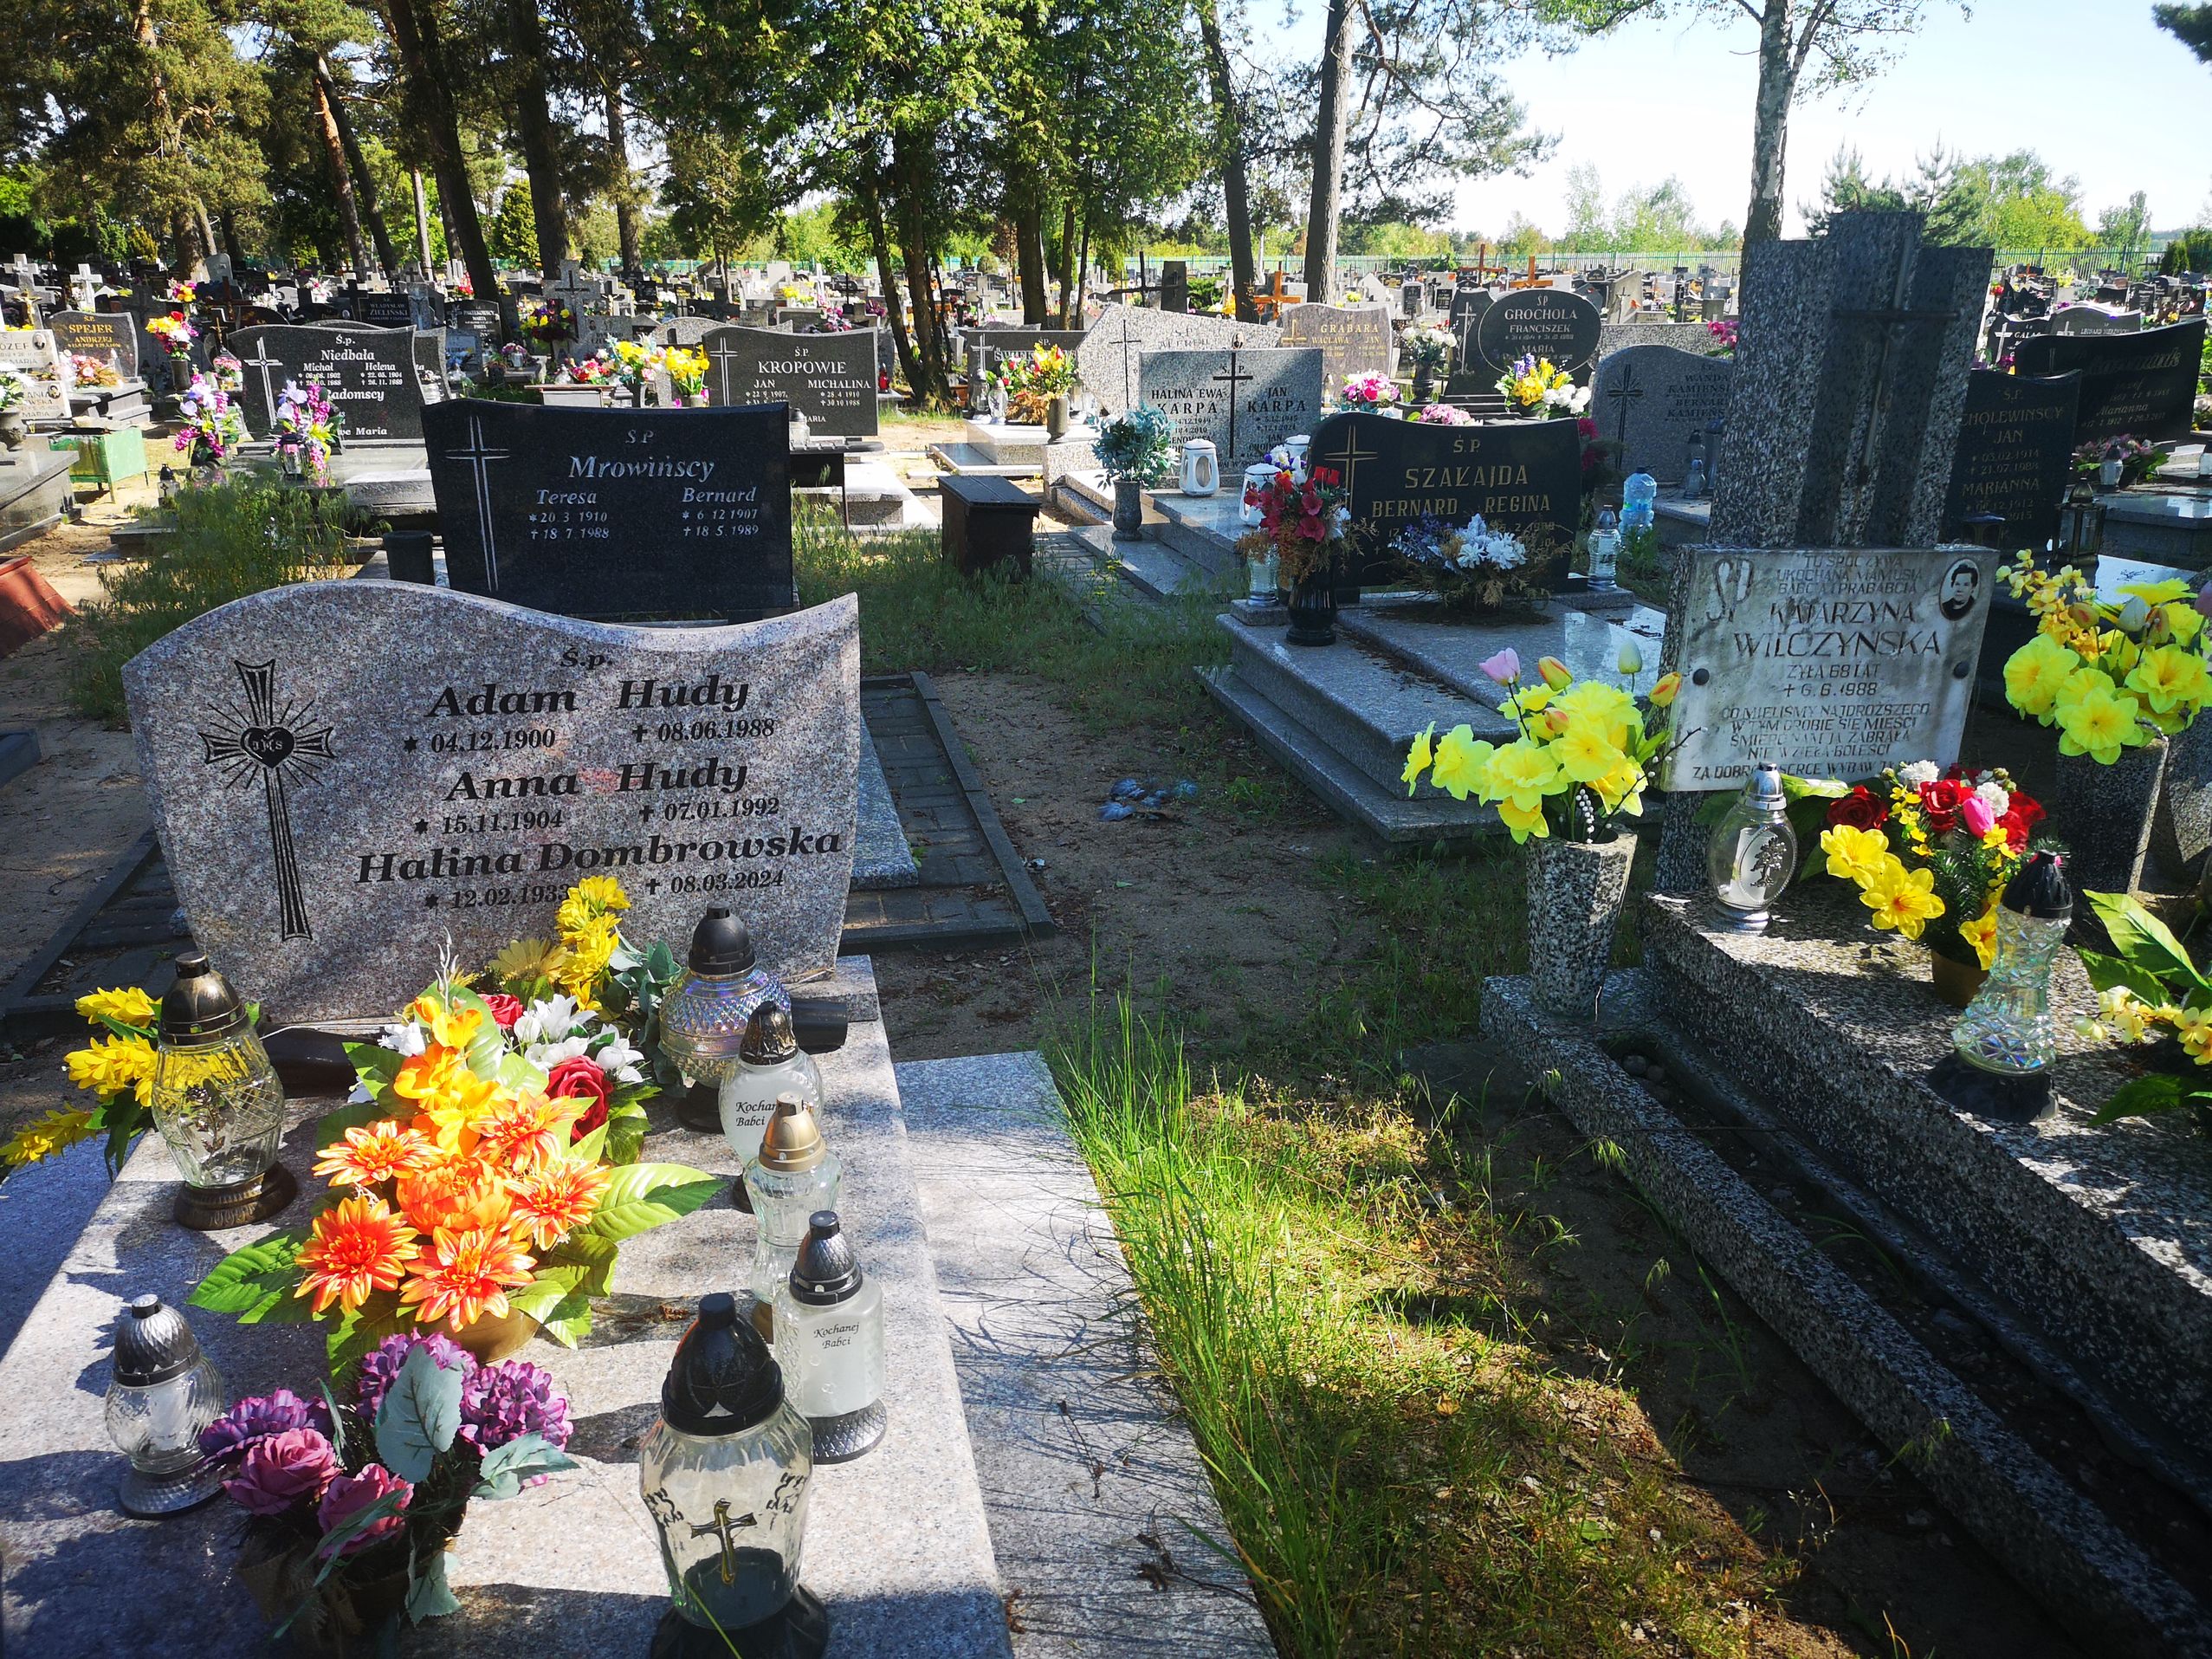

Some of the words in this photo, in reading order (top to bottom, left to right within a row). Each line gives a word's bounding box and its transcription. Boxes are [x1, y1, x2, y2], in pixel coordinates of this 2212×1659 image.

[1504, 308, 1578, 321] GROCHOLA
[69, 324, 114, 334] SPEJER
[1321, 324, 1379, 333] GRABARA
[1510, 324, 1571, 334] FRANCISZEK
[336, 334, 356, 347] Ś.p.
[320, 348, 375, 360] Niedbała
[303, 362, 334, 373] Michał
[365, 362, 396, 371] Helena
[758, 360, 847, 374] KROPOWIE
[754, 379, 776, 388] JAN
[807, 379, 871, 389] MICHALINA
[1151, 390, 1193, 399] HALINA
[1199, 388, 1224, 399] EWA
[1267, 388, 1287, 399] JAN
[1157, 402, 1218, 414] KARPA
[1247, 400, 1307, 412] KARPA
[1994, 430, 2023, 444] JAN
[568, 456, 715, 483] Mrowińscy
[1405, 464, 1529, 489] SZAŁAJDA
[1963, 478, 2041, 497] MARIANNA
[537, 489, 597, 504] Teresa
[682, 487, 757, 502] Bernard
[1372, 497, 1458, 518] BERNARD
[1484, 495, 1550, 515] REGINA
[1770, 601, 1916, 624] KATARZYNA
[560, 648, 613, 671] Ś.p.
[1829, 664, 1852, 678] 68
[424, 684, 579, 717] Adam
[615, 674, 749, 712] Hudy
[431, 729, 556, 754] 04.12.1900
[657, 718, 776, 742] 08.06.1988
[442, 771, 580, 801] Anna
[615, 757, 748, 794] Hudy
[1692, 766, 1711, 780] ZA
[442, 809, 563, 835] 15.11.1904
[663, 797, 780, 821] 07.01.1992
[355, 847, 525, 884] Halina
[537, 826, 843, 872] Dombrowska
[452, 884, 571, 910] 12.02.1933
[670, 869, 785, 894] 08.03.2024
[736, 1116, 766, 1126] Babci
[813, 1322, 859, 1338] Kochanej
[822, 1336, 851, 1349] Babci
